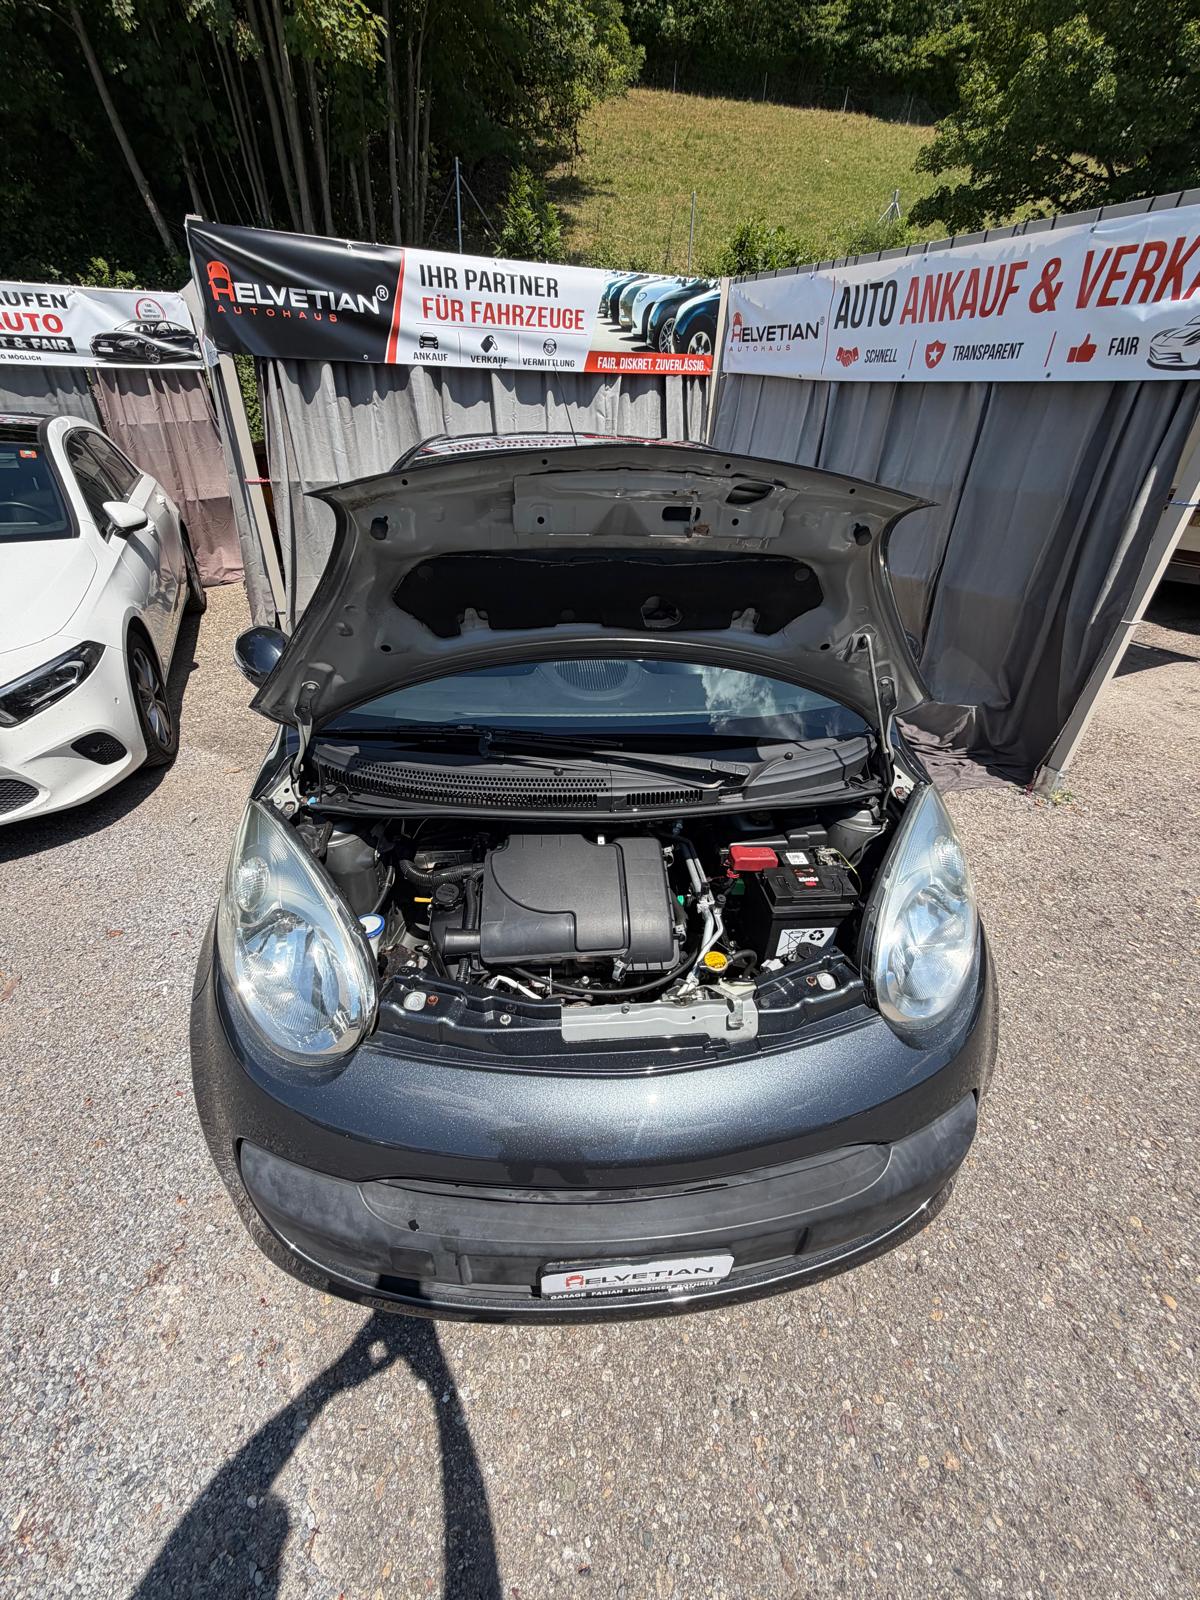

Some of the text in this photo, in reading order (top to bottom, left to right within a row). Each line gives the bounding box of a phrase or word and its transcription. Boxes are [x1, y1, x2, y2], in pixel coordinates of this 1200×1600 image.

[419, 264, 559, 298] IHR PARTNER
[833, 279, 898, 330] AUTO
[899, 260, 1029, 325] ANKAUF
[1028, 257, 1064, 314] &
[217, 304, 338, 323] AUTOHAUS
[422, 295, 585, 330] FÜR FAHRZEUGE
[13, 337, 29, 348] &
[30, 338, 71, 351] FAIR
[728, 344, 791, 352] AUTOHAUS
[1107, 336, 1140, 356] FAIR
[413, 352, 448, 361] ANKAUF
[864, 349, 897, 364] SCHNELL
[952, 342, 1024, 361] TRANSPARENT
[470, 355, 509, 364] VERKAUF
[522, 358, 575, 367] VERMITTLUNG
[620, 358, 654, 370] DISKRET.
[550, 1292, 587, 1300] GARAGE
[591, 1289, 623, 1297] FABIAN
